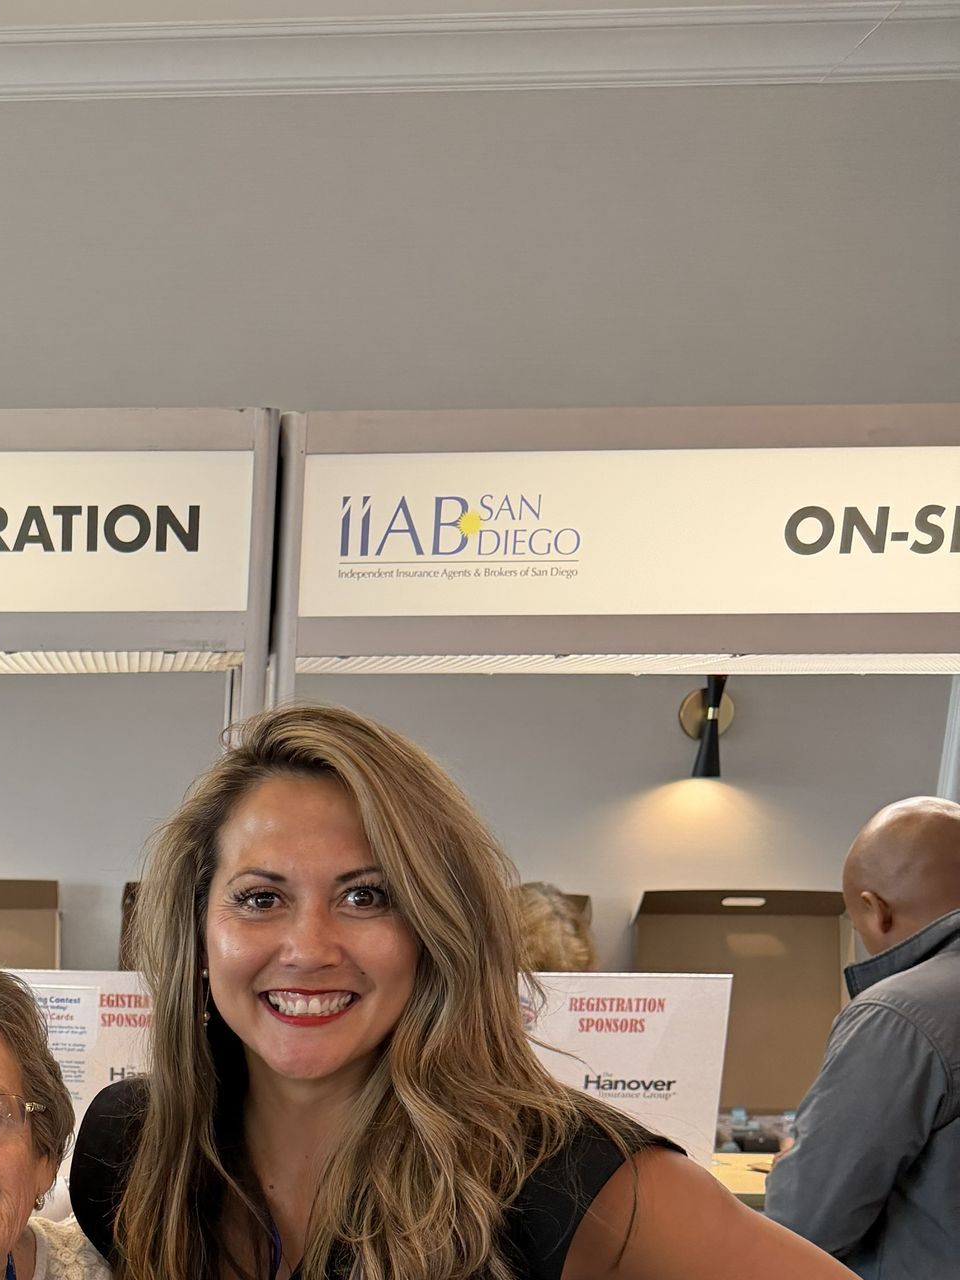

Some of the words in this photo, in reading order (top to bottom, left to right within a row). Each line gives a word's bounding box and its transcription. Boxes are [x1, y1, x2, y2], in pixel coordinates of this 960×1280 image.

[479, 494, 542, 521] SAN
[477, 528, 581, 556] DIEGO
[338, 569, 394, 582] Independent
[396, 568, 440, 579] Insurance
[441, 568, 472, 581] Agents
[473, 568, 481, 577] &
[484, 567, 518, 578] Brokers
[520, 565, 530, 578] of
[531, 566, 549, 577] San
[550, 565, 579, 579] Diego
[569, 997, 666, 1013] REGISTRATION
[578, 1017, 646, 1033] SPONSORS
[584, 1074, 677, 1092] Hanover
